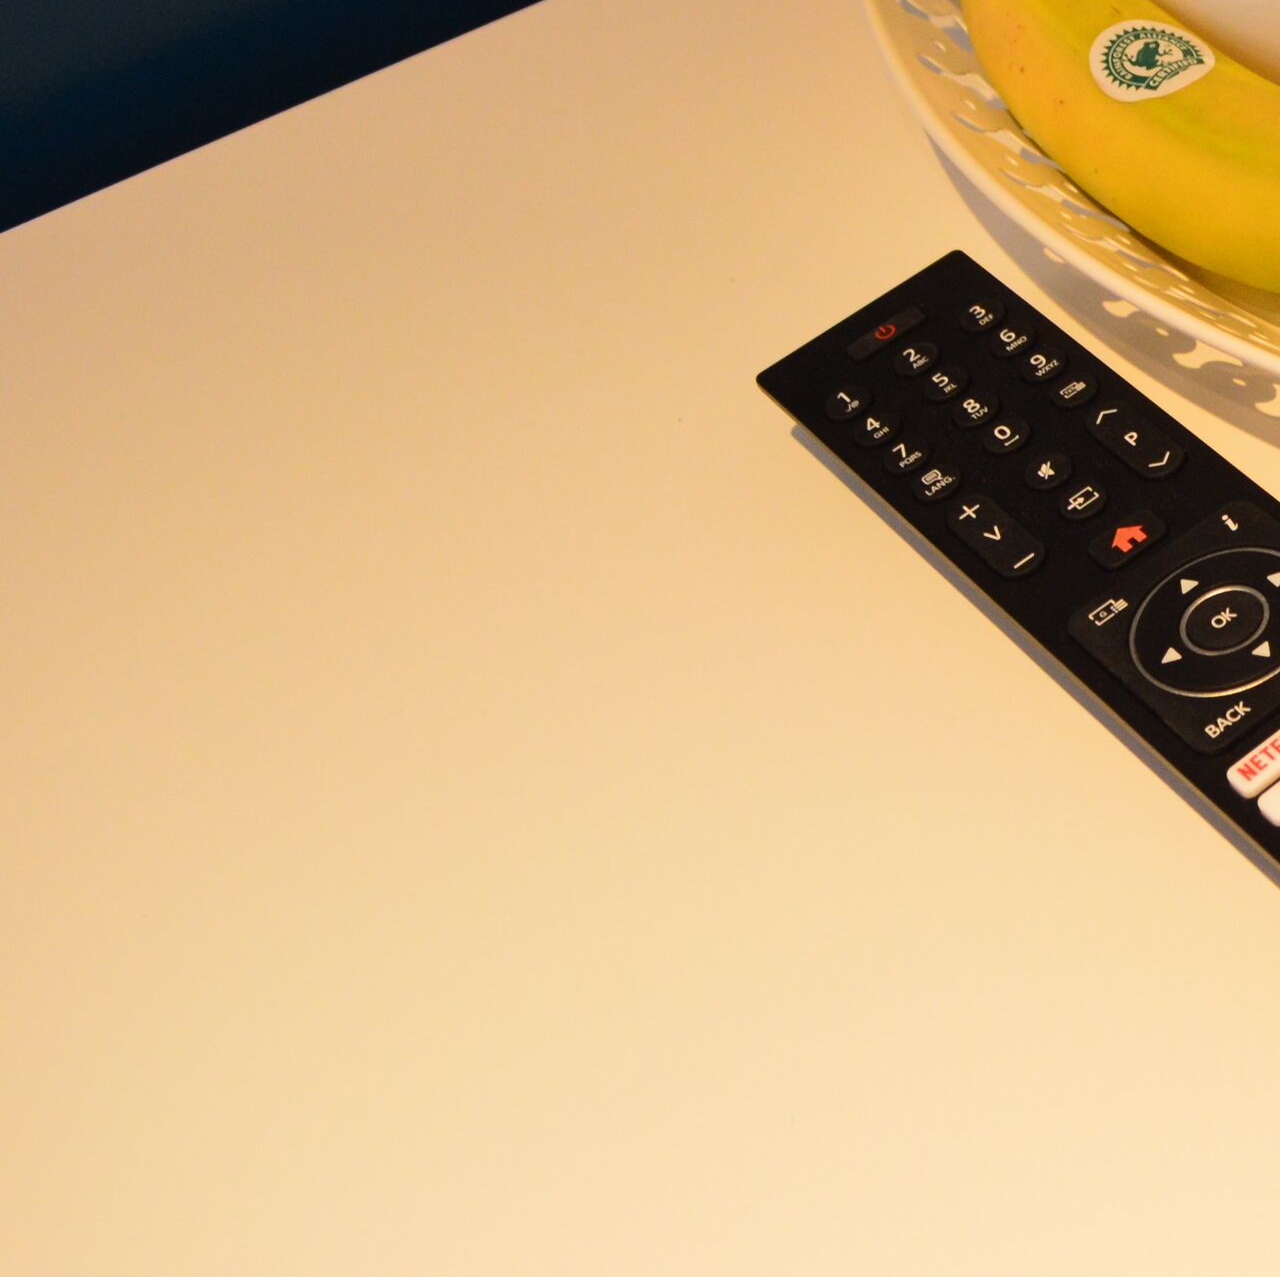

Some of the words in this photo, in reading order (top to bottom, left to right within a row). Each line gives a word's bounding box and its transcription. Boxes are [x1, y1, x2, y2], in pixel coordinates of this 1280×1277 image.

[970, 304, 986, 319] 3
[999, 328, 1016, 343] 6
[1006, 335, 1028, 353] MNO
[902, 347, 921, 363] 2
[912, 355, 929, 370] ABC
[1029, 353, 1047, 369] 9
[1035, 359, 1060, 377] WXYZ
[931, 372, 949, 388] 5
[836, 391, 852, 404] 1
[962, 398, 980, 414] 8
[971, 405, 989, 421] TUV
[866, 417, 881, 432] 4
[873, 426, 890, 440] GHI
[1123, 431, 1139, 447] P
[891, 443, 907, 459] 7
[898, 450, 923, 469] PQRS
[924, 474, 957, 497] LANG.
[1210, 607, 1238, 629] OK
[1204, 701, 1251, 739] BACK
